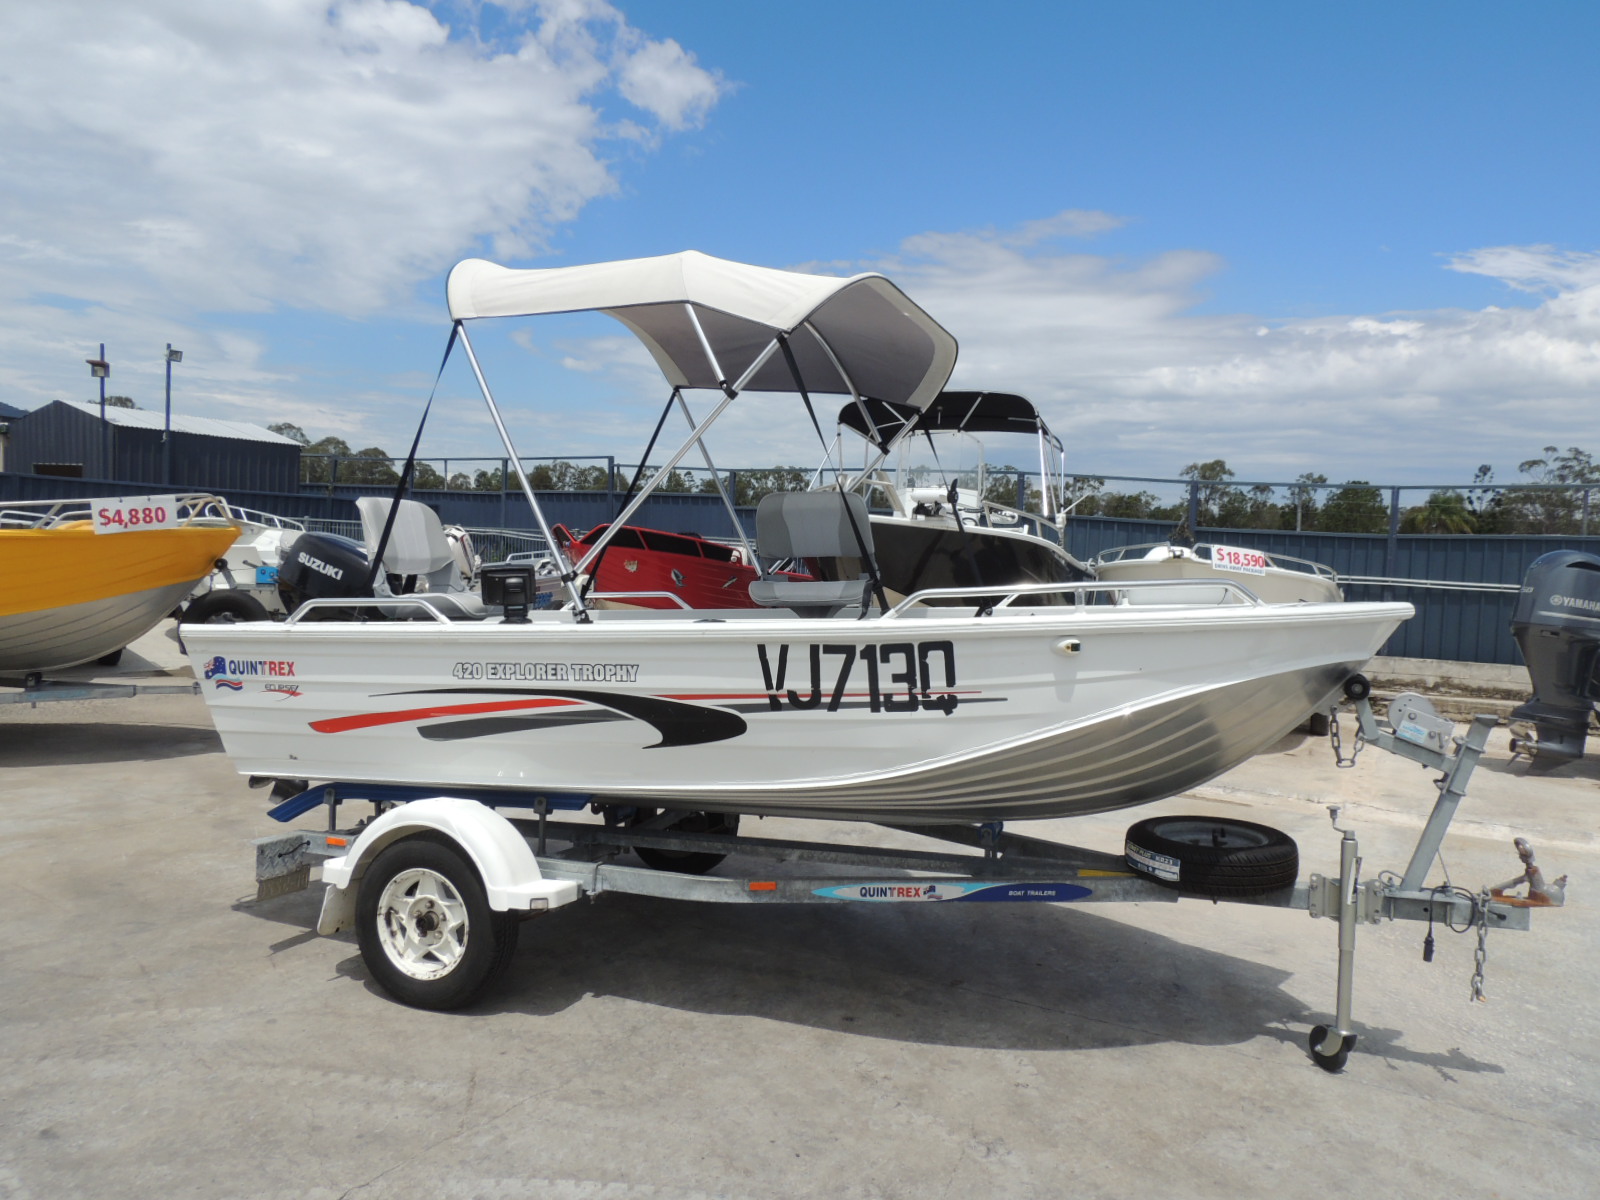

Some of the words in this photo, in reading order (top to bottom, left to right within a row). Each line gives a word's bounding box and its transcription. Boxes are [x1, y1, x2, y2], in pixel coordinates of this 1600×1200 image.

[98, 506, 166, 529] $4,880
[298, 551, 343, 580] SUZUKI
[228, 659, 295, 677] QUINTREX
[452, 662, 483, 680] 420
[486, 662, 569, 681] EXPLORER
[571, 664, 640, 682] TROPHY
[860, 886, 922, 898] QUINTREX
